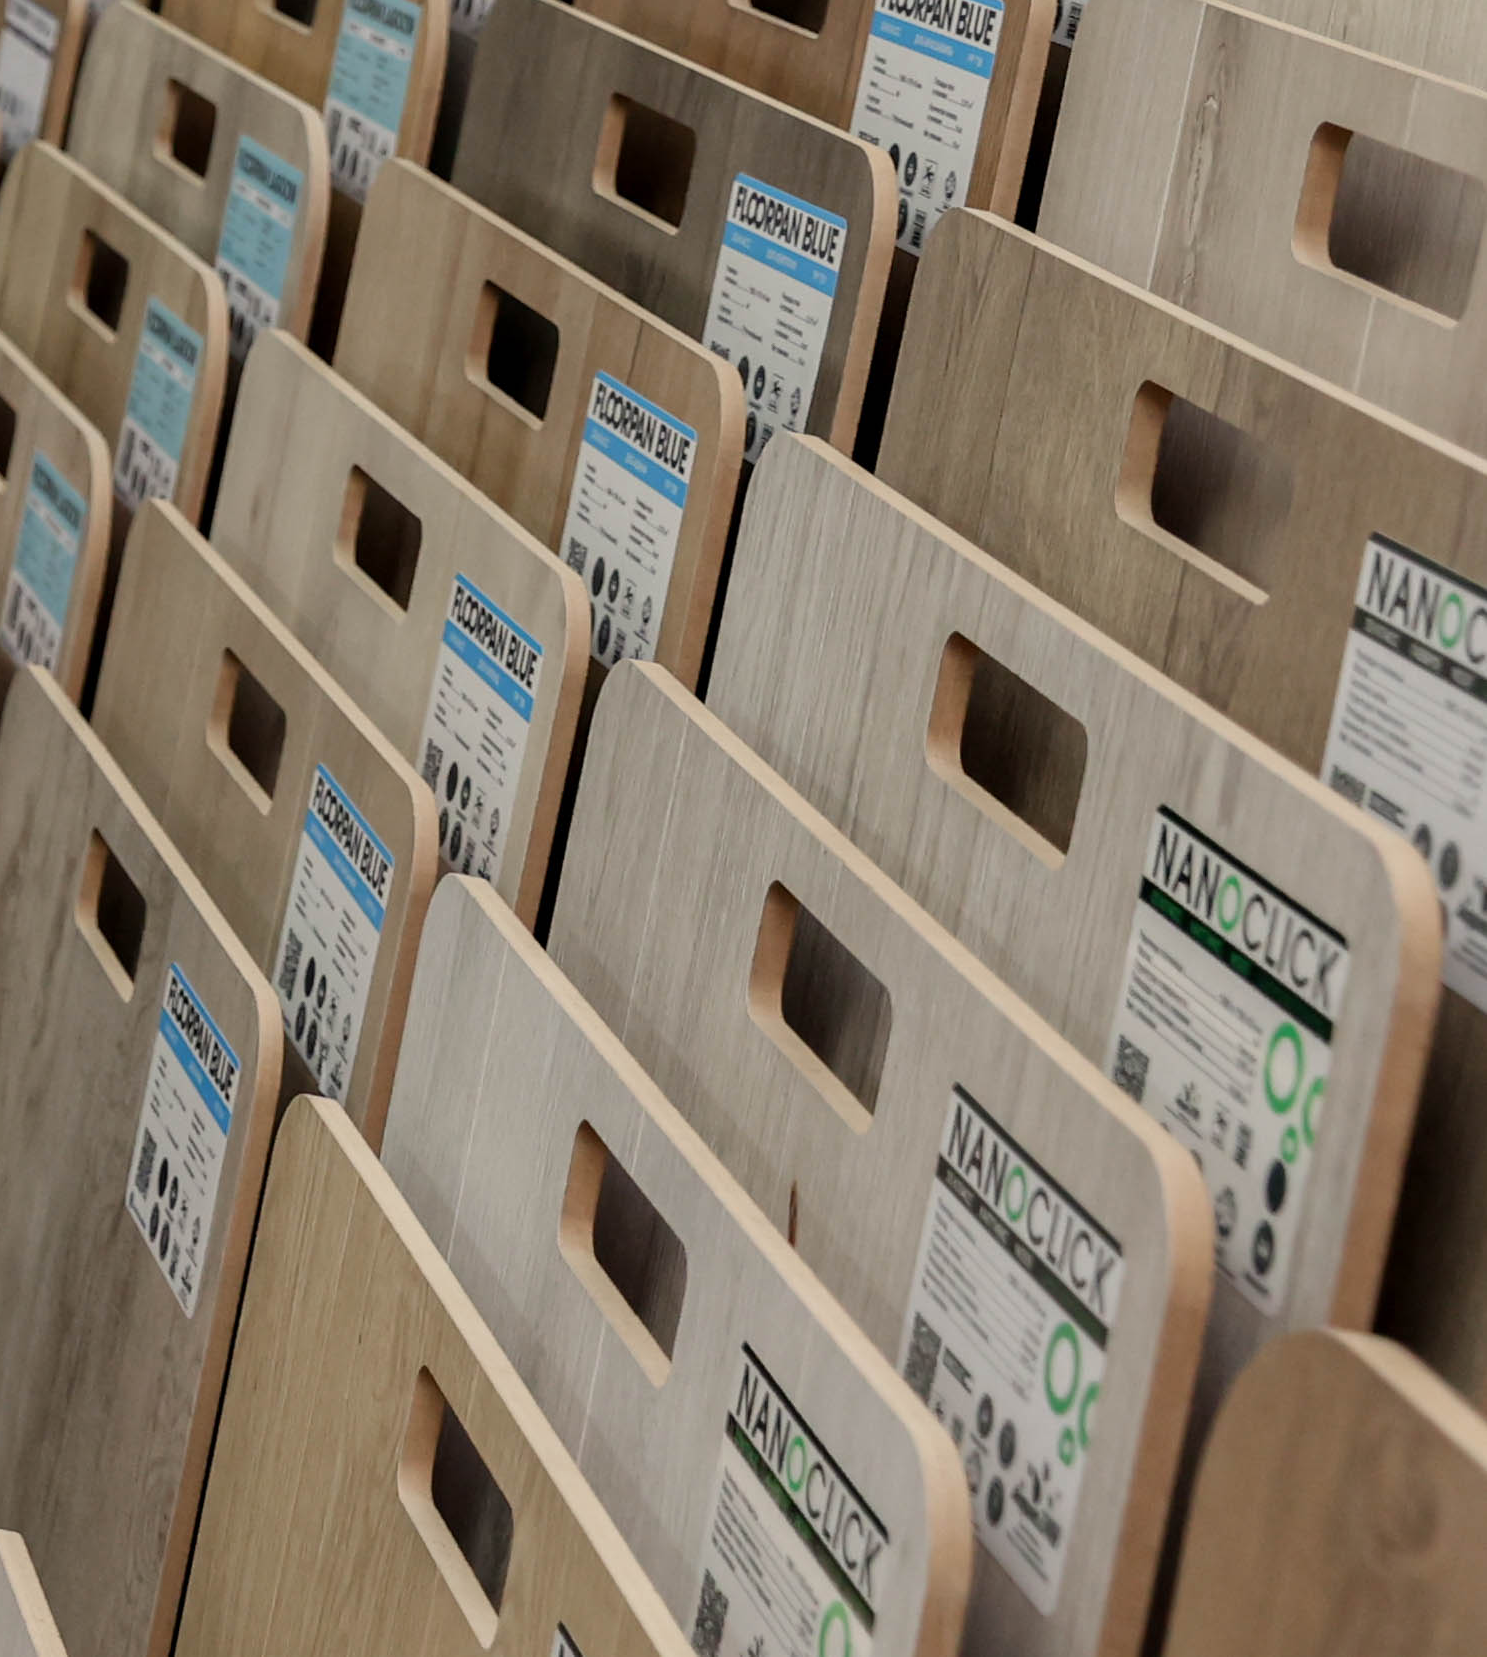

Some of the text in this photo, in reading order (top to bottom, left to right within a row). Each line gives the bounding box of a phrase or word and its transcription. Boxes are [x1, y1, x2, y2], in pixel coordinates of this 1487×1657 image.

[955, 1, 997, 45] BLUE
[732, 186, 804, 247] FLOORPAN
[801, 216, 839, 264] BLUE
[592, 383, 658, 453] FLOORPAN
[655, 423, 690, 475] BLUE
[451, 585, 538, 690] FLOORPAN BLUE
[1366, 552, 1487, 665] NANOC
[360, 838, 389, 899] BLUE
[1152, 823, 1339, 1009] NANOCLICK
[209, 1041, 235, 1102] BLUE
[948, 1104, 1118, 1317] NANOCLICK
[736, 1363, 882, 1599] NANOCLICK
